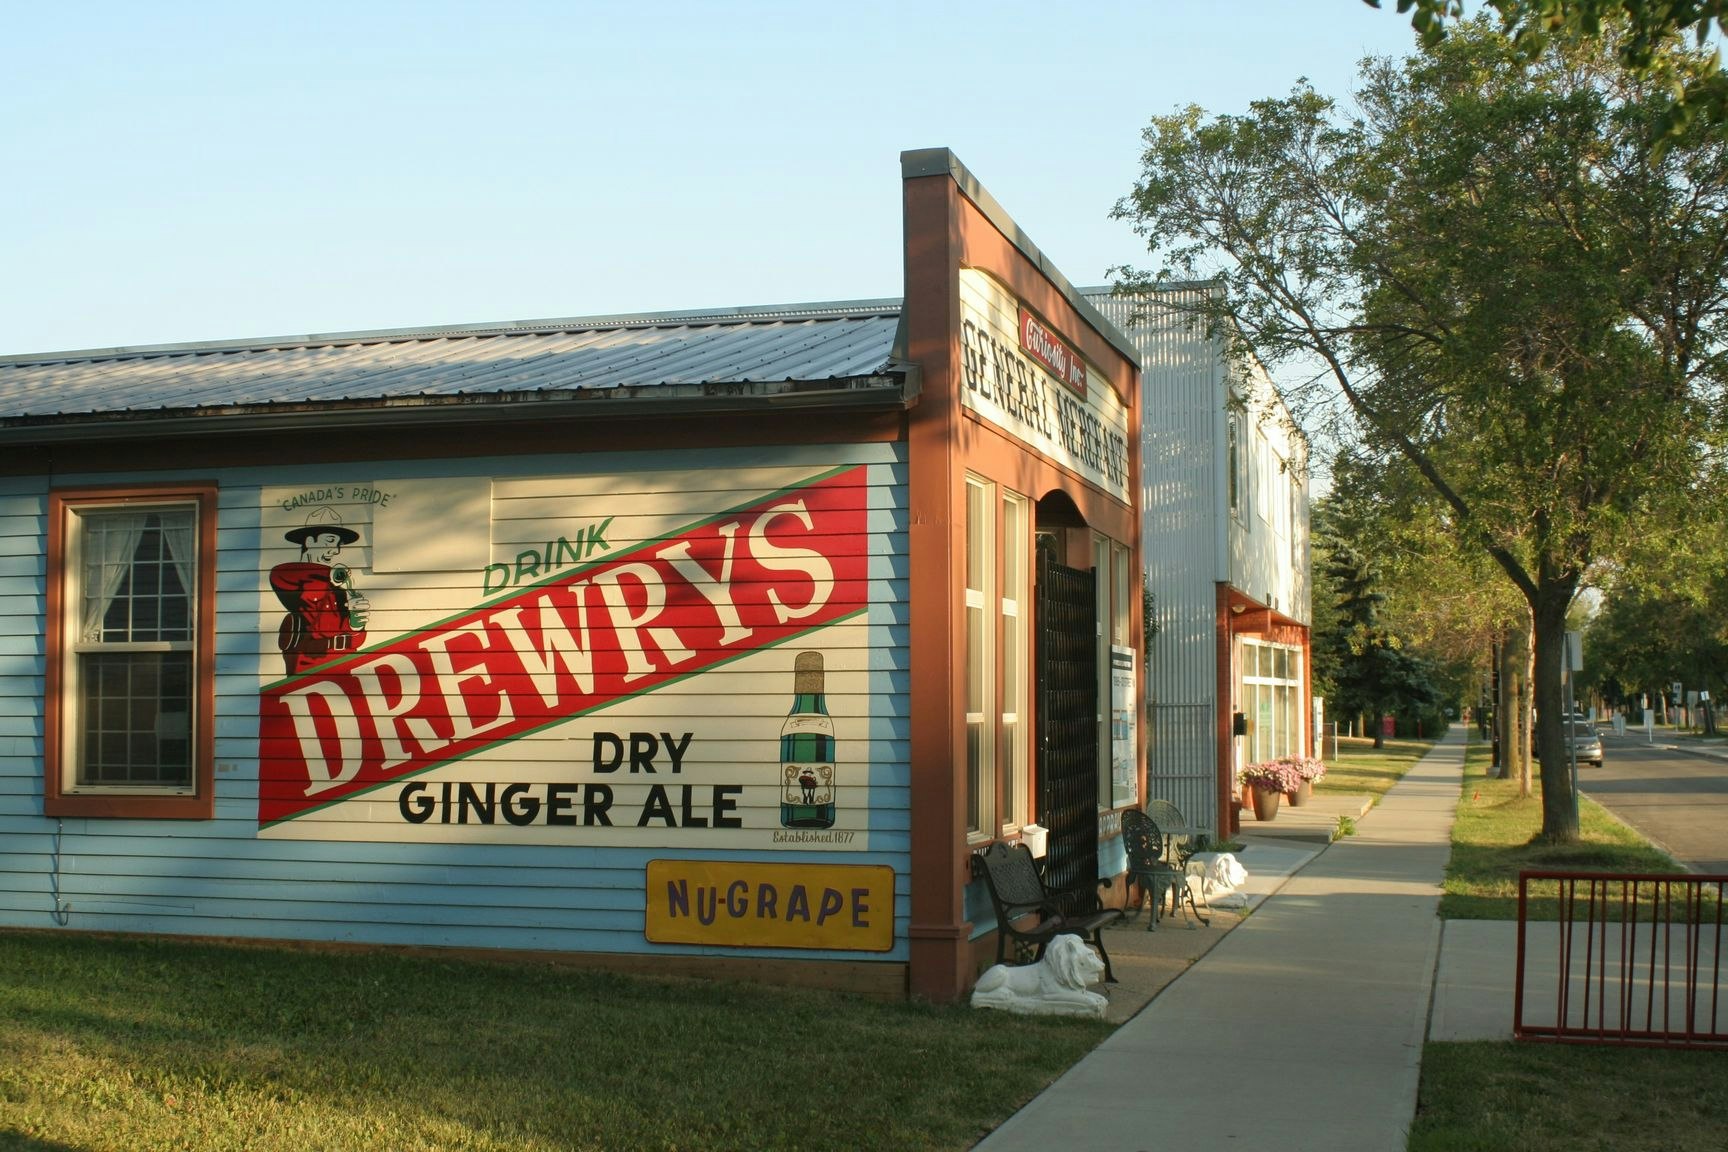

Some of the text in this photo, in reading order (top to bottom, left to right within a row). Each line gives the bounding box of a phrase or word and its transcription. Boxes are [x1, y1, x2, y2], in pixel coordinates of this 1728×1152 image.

[963, 318, 1124, 488] GENERAL MERCHANT
[483, 516, 615, 597] DRINK
[279, 499, 836, 798] DREWRYS
[593, 732, 693, 774] DRY
[399, 781, 743, 828] GINGER ALE
[772, 831, 855, 844] Established 1877
[667, 878, 870, 928] NU-GRAPE
